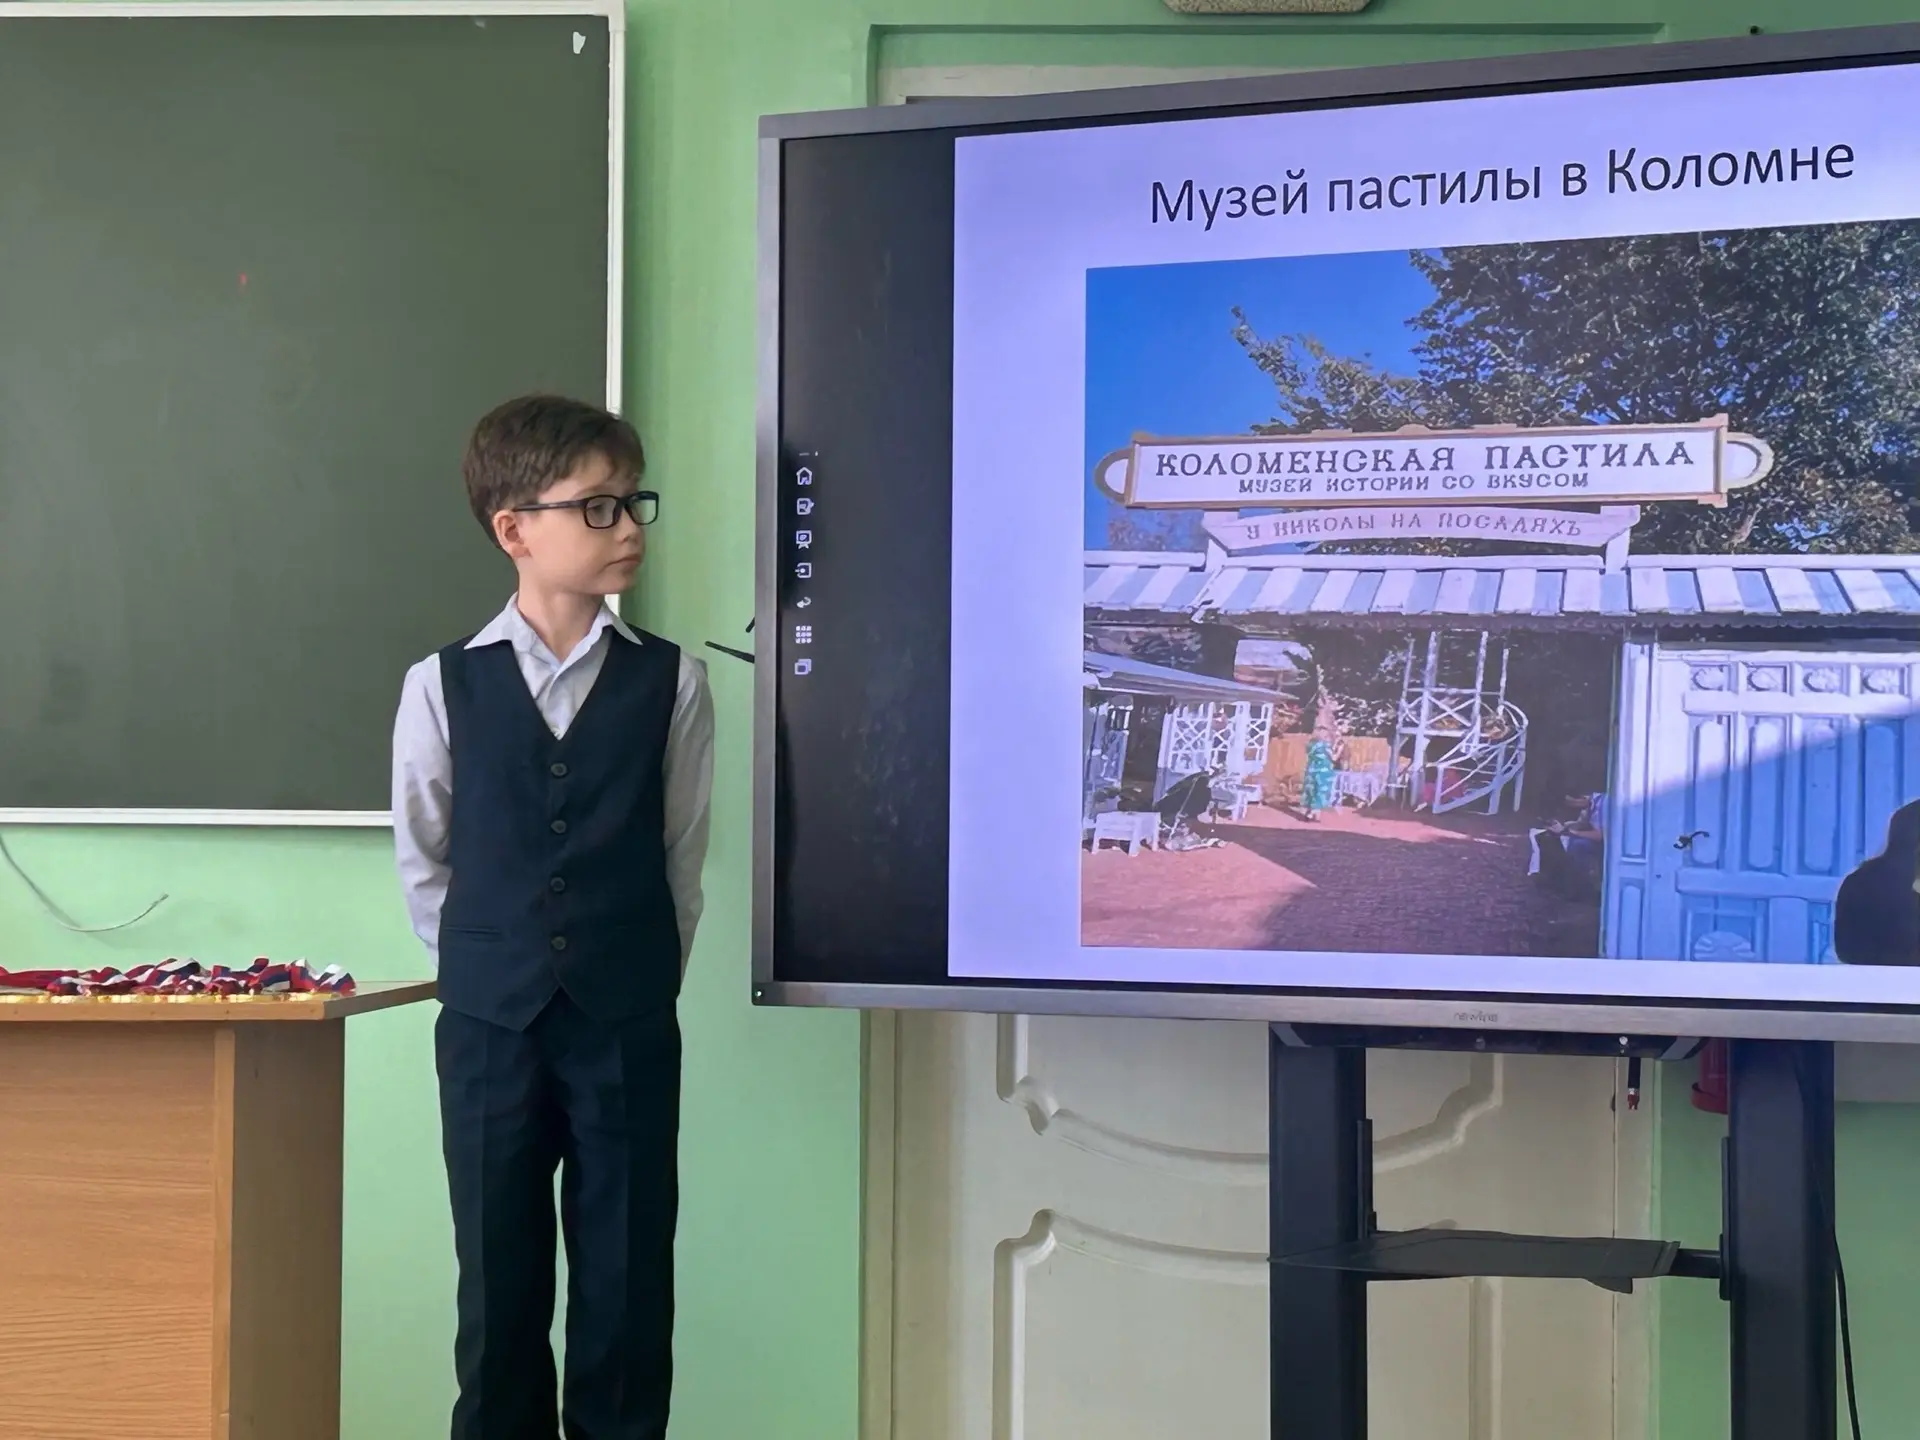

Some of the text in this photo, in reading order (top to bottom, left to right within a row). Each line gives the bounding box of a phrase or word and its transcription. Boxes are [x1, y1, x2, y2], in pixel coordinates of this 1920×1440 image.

[1152, 143, 1854, 231] Музей пастилы в Коломне
[1155, 441, 1694, 477] КОЛОМЕНСКАЯ ПАСТИЛА
[1326, 475, 1430, 493] ИСТОРИИ
[1442, 474, 1475, 490] СО
[1487, 472, 1589, 489] ВКУСОМ
[1391, 512, 1422, 528] НА
